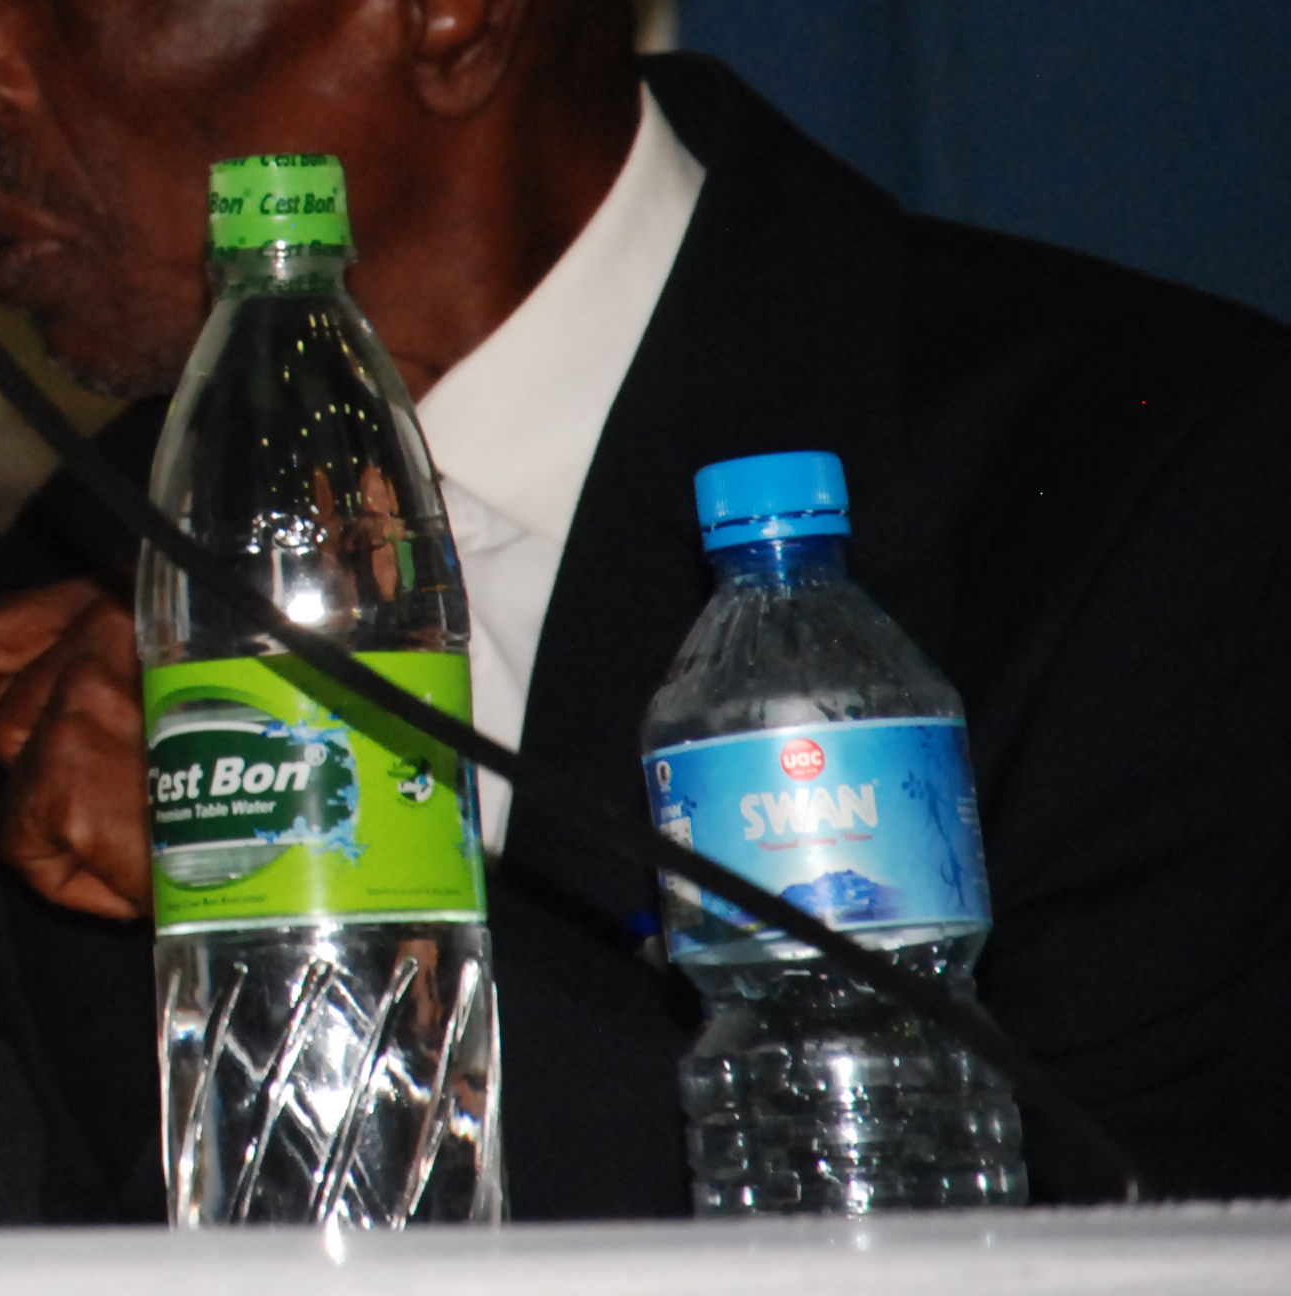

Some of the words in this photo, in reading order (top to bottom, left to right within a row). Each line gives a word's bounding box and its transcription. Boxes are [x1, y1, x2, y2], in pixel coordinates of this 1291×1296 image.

[259, 193, 300, 215] Cest
[303, 192, 336, 214] Bon
[148, 762, 204, 803] 'est
[209, 756, 312, 797] Bon
[194, 802, 229, 819] Table
[231, 799, 277, 816] Water
[740, 783, 879, 841] SWAN
